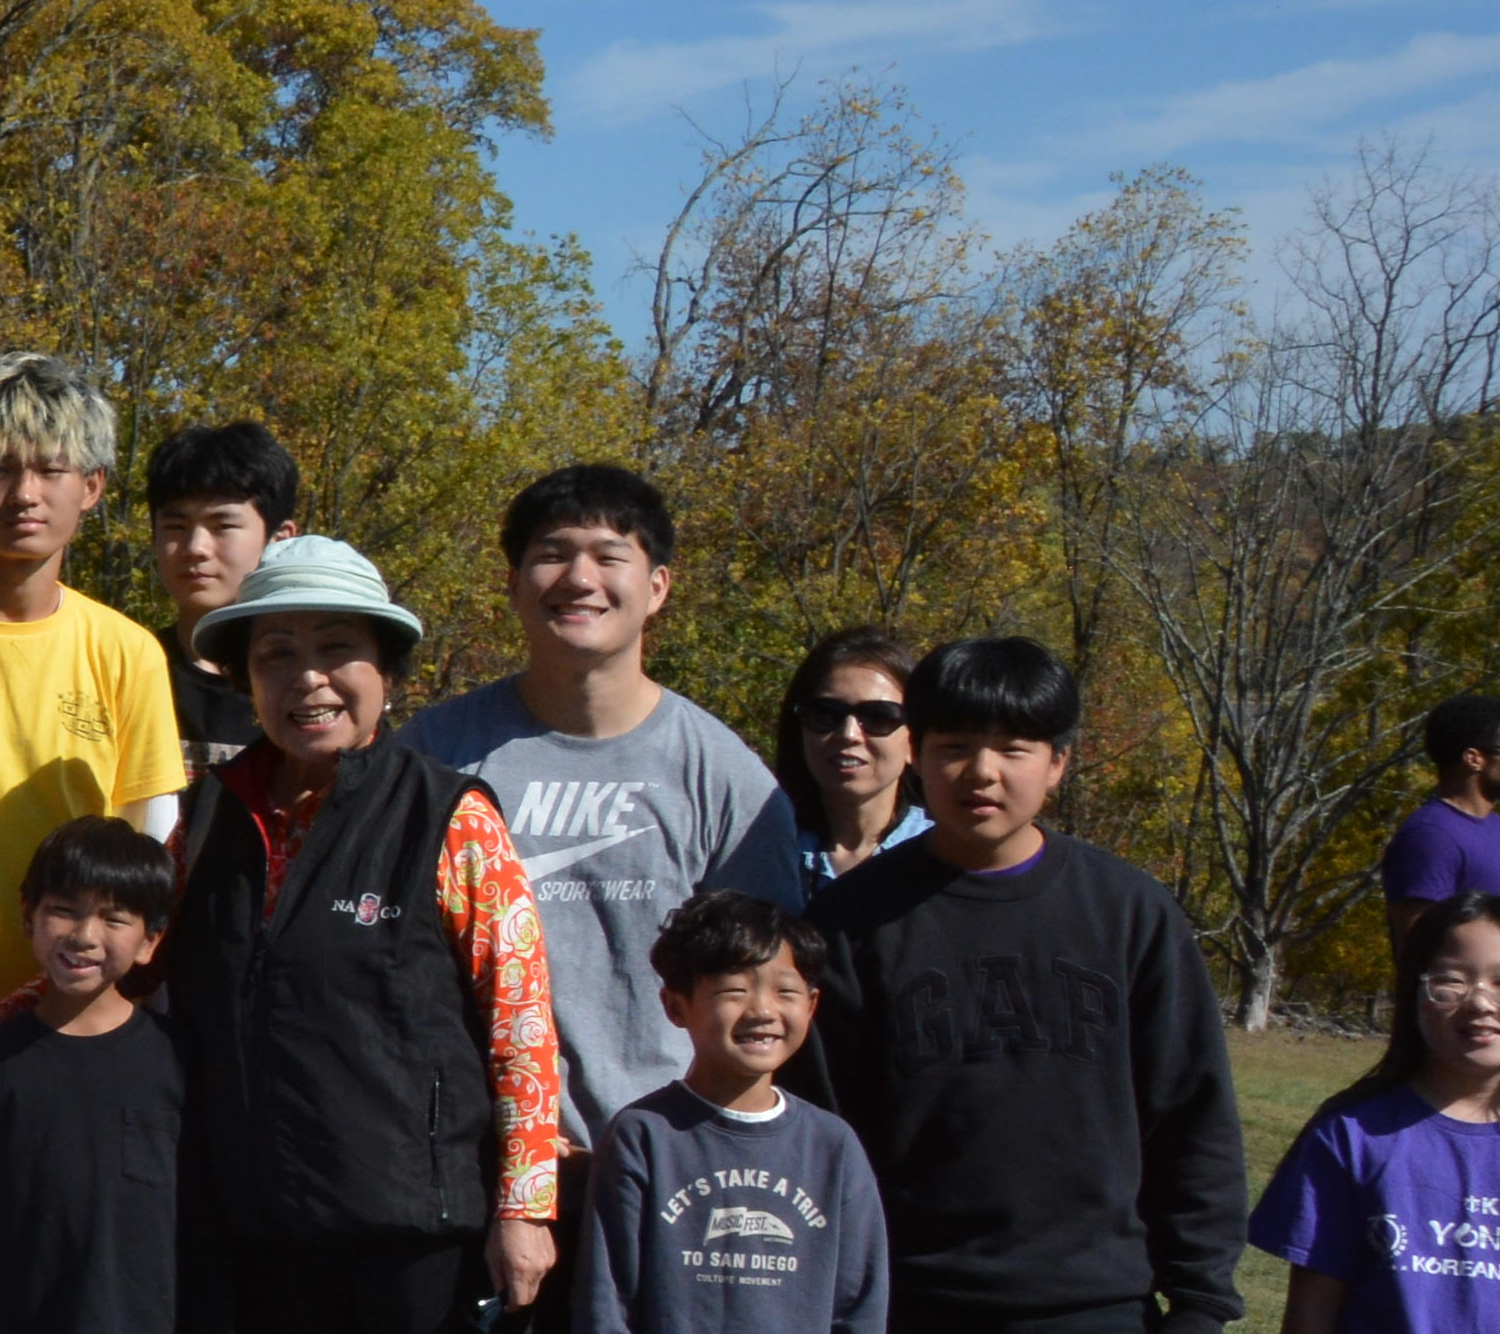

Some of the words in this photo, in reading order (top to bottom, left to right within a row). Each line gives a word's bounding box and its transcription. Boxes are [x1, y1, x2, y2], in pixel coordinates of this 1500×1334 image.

[510, 781, 645, 837] NIKE
[537, 880, 656, 903] SPORWEAR
[893, 953, 1120, 1065] GAP
[660, 1177, 711, 1225] LET'S
[714, 1168, 770, 1189] TAKE
[773, 1178, 788, 1197] A
[791, 1187, 828, 1229] TRIP
[682, 1251, 703, 1266] TO
[710, 1252, 745, 1269] SAN
[751, 1255, 798, 1273] DIEGO
[739, 1276, 782, 1287] MOVEMENT
